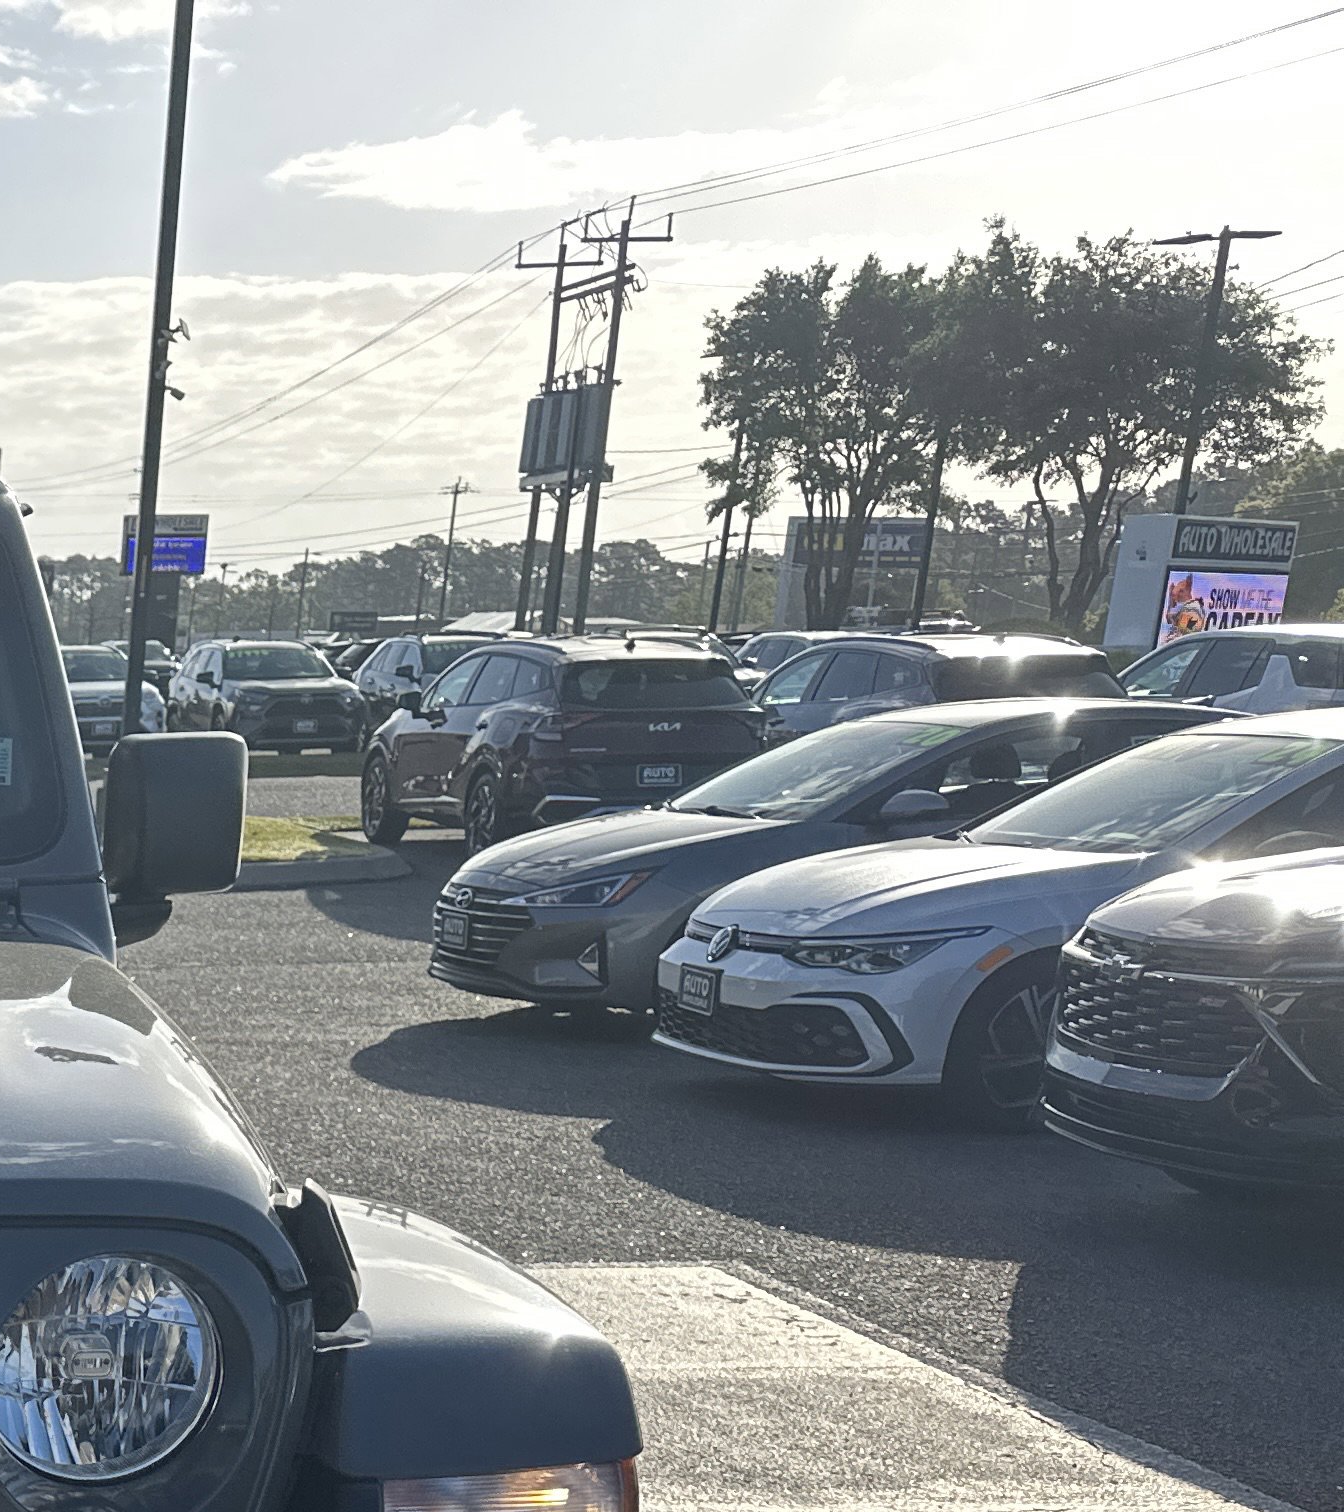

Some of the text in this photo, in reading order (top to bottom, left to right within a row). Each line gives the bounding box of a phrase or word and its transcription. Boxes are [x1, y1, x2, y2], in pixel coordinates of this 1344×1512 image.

[1179, 525, 1294, 557] AUTO WHOLESALE
[1208, 588, 1241, 610] SHOW
[643, 767, 675, 777] AUTO
[683, 974, 709, 997] AUTO
